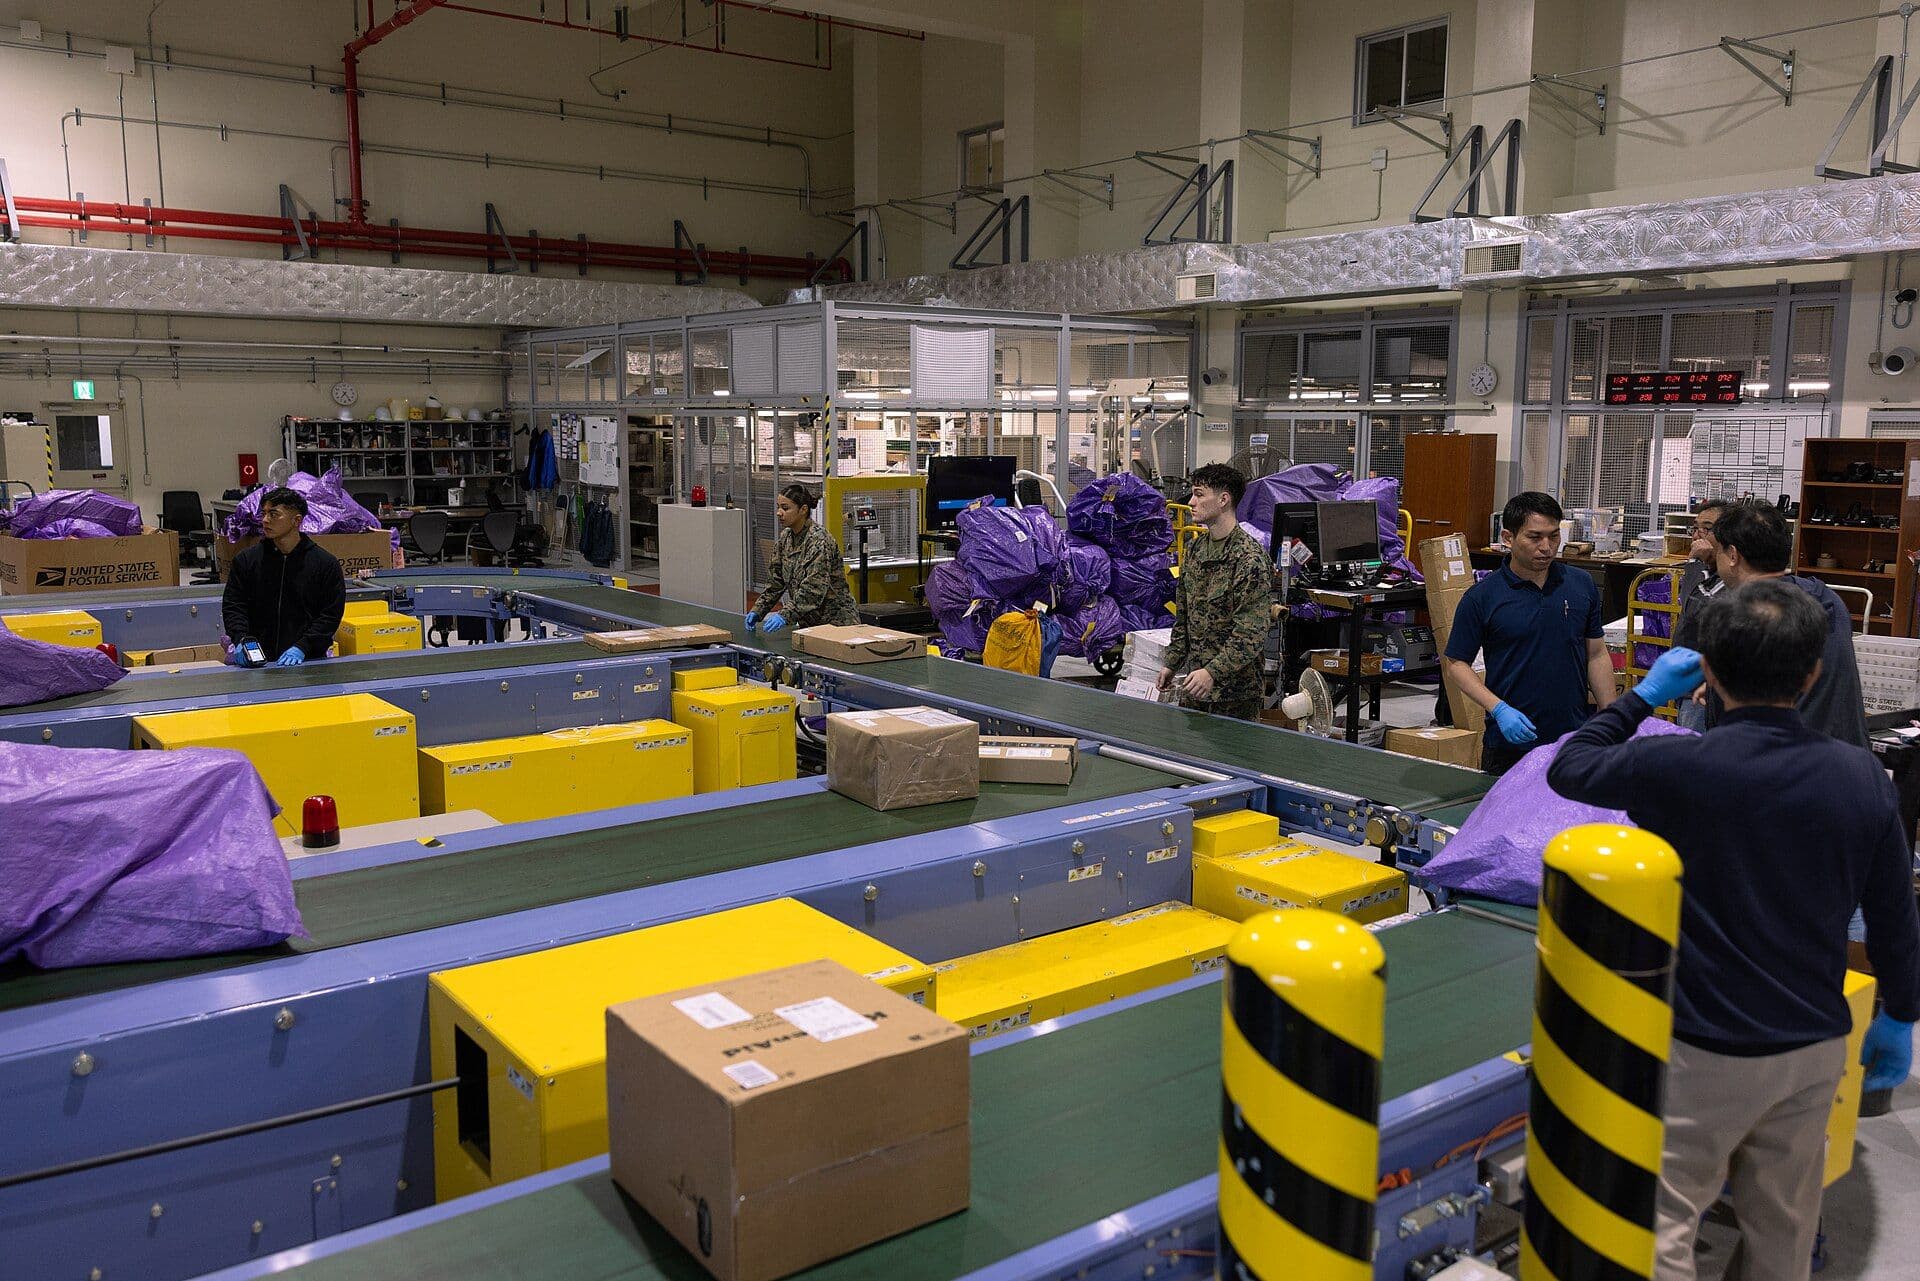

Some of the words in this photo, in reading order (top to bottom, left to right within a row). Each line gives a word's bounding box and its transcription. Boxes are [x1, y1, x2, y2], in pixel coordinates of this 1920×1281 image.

[345, 557, 380, 566] STATES
[70, 564, 115, 576] UNITED
[118, 561, 155, 572] STATES
[68, 574, 112, 586] POSTAL
[1878, 698, 1903, 706] STATES
